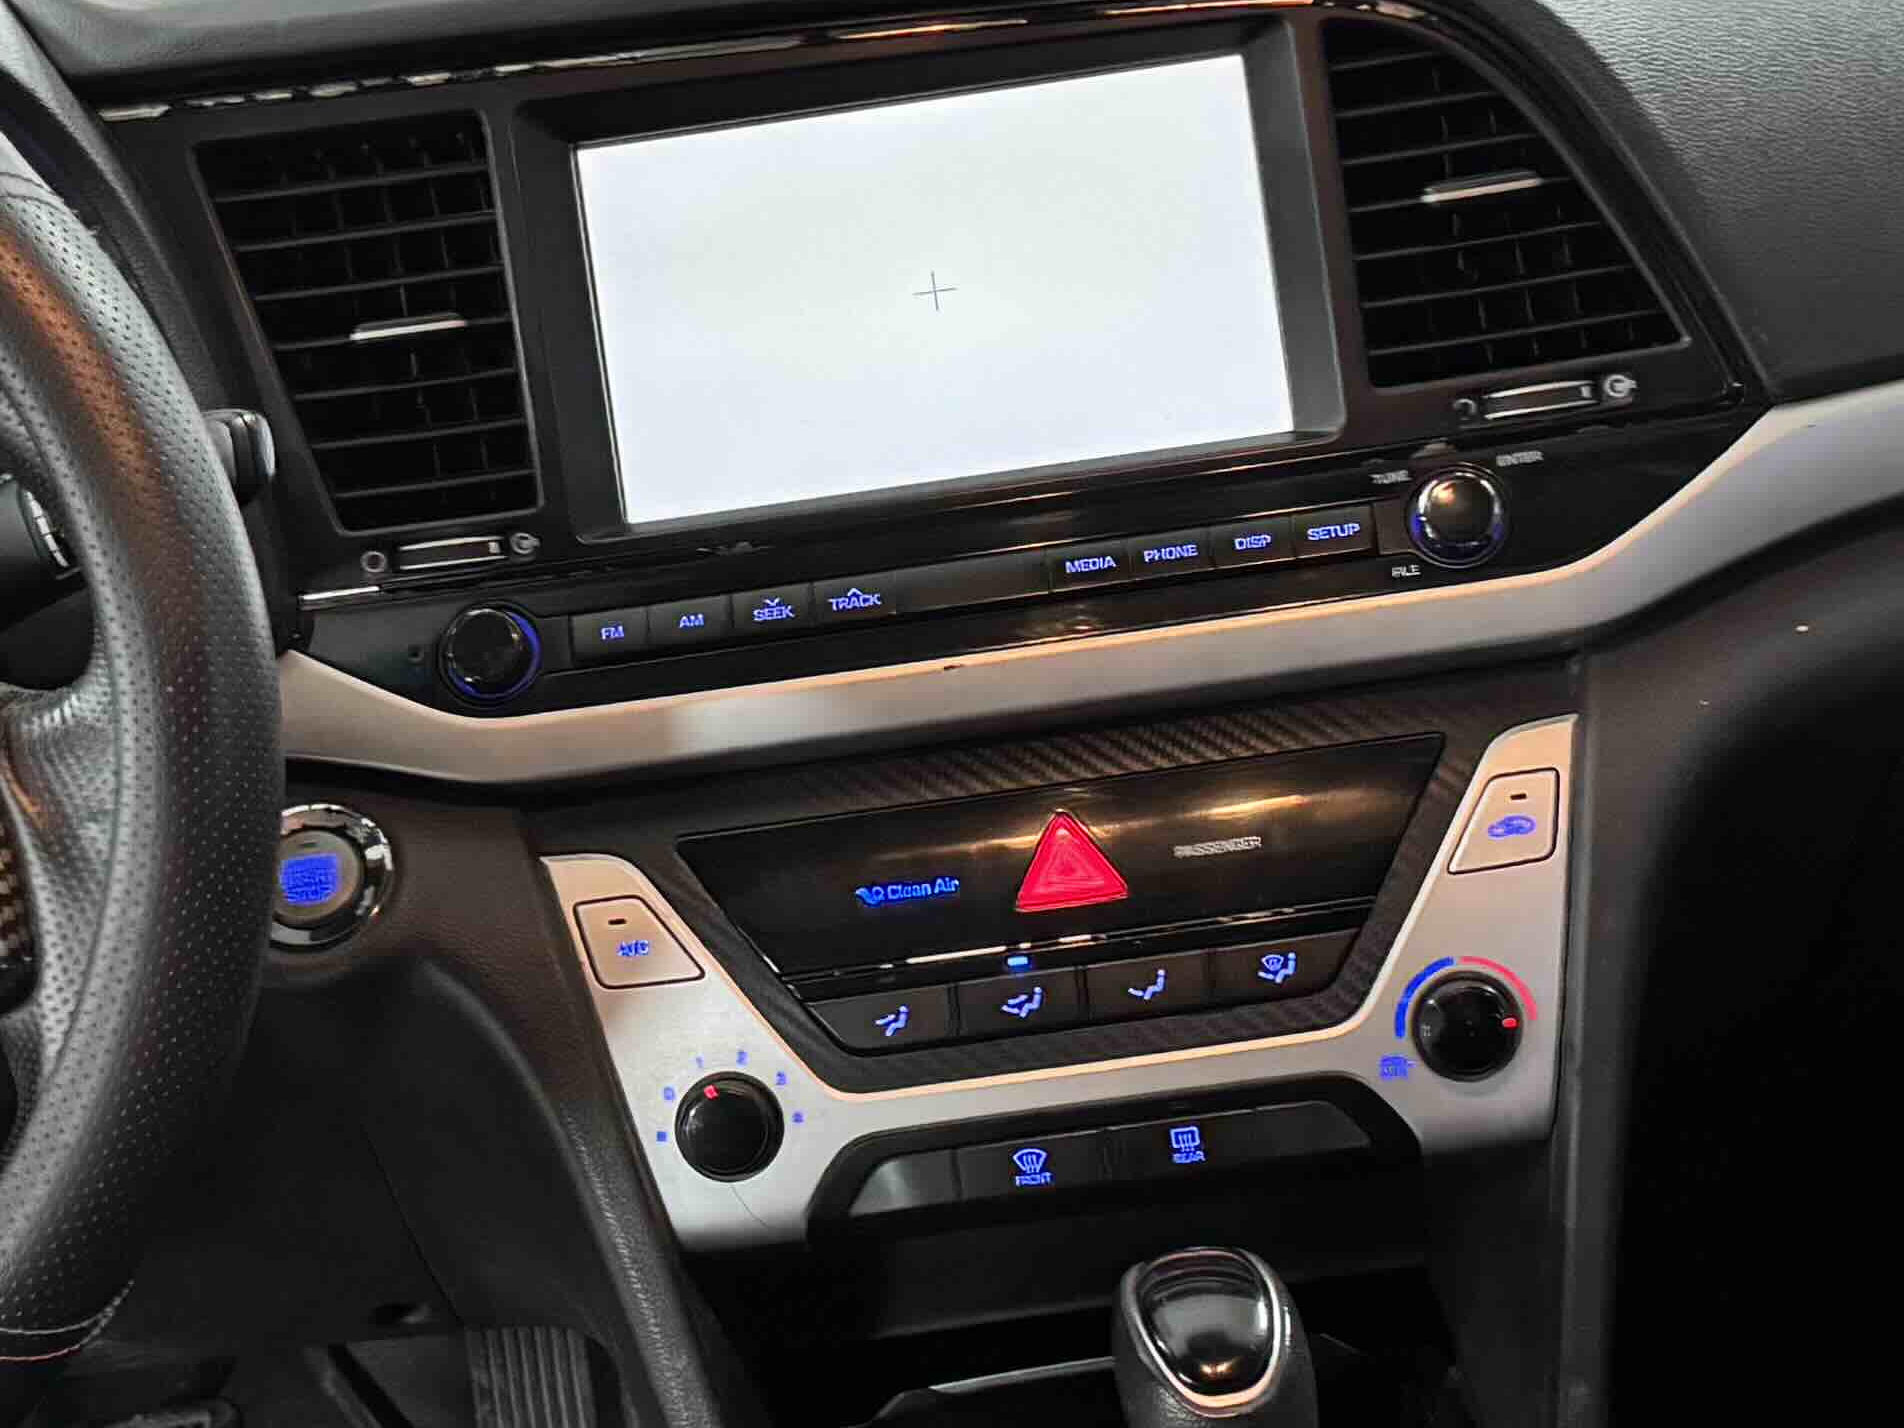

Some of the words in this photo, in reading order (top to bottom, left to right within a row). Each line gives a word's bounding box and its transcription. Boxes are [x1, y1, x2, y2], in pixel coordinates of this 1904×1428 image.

[1065, 555, 1118, 575] MEDIA
[1143, 544, 1200, 564] PHONE
[1234, 534, 1274, 552] DISP
[1307, 523, 1363, 542] SETUP
[600, 625, 627, 641] FM
[679, 614, 706, 629] AM
[753, 605, 796, 623] SEEK
[829, 593, 883, 613] TRACK
[933, 876, 961, 895] Air
